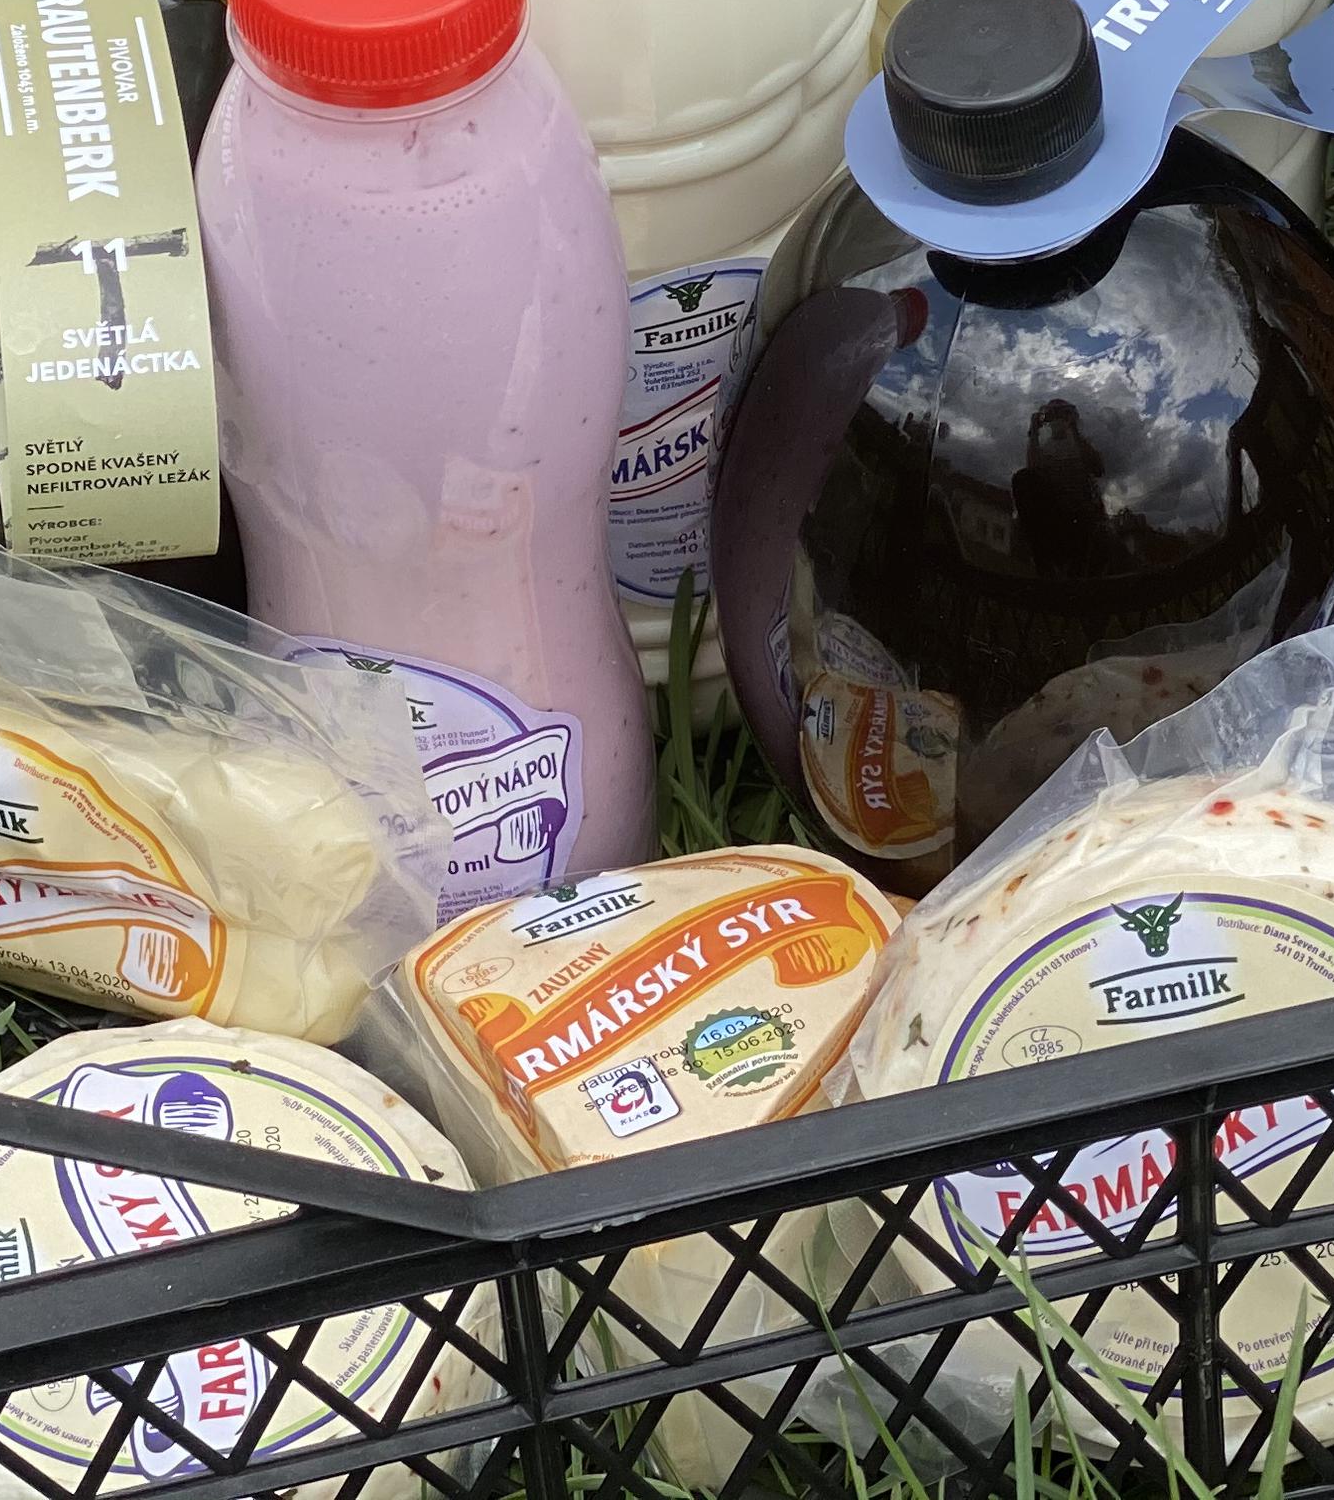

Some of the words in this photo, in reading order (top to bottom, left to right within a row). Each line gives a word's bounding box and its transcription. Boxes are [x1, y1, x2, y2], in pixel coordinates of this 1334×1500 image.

[10, 24, 29, 67] Založeno
[17, 68, 34, 94] 1045
[107, 38, 139, 103] PIVOVAR
[70, 237, 129, 275] 11
[62, 316, 160, 349] SVĚTLÁ
[644, 312, 738, 348] Farmilk
[25, 349, 201, 383] JEDENÁCTKA
[25, 436, 84, 456] SVĚTLÝ
[26, 456, 97, 476] SPODNĚ
[101, 450, 180, 470] KVAŠENÝ
[611, 413, 713, 485] MÁŘSK
[27, 470, 154, 495] NEFILTROVANÝ
[158, 468, 212, 485] LEŽÁK
[27, 518, 103, 531] VÝROBCE:
[29, 534, 89, 546] Pivovar
[494, 752, 558, 799] NÁPOJ
[466, 854, 491, 873] ml
[524, 893, 642, 940] Farmilk
[718, 898, 817, 949] SÝR
[1217, 916, 1263, 934] Distribuce:
[1263, 924, 1291, 943] Diana
[1291, 934, 1319, 954] Seven
[1035, 966, 1053, 984] 541
[1050, 958, 1063, 972] 03
[1059, 940, 1093, 966] Trutnov
[1273, 943, 1293, 958] 541
[1292, 950, 1305, 963] 03
[48, 960, 131, 991] 13.04.2020
[527, 941, 612, 1006] ZAUZENÝ
[1102, 969, 1233, 1014] Farmilk
[577, 1064, 630, 1094] datum
[700, 1002, 793, 1045] 16.03.2020
[1020, 1040, 1065, 1059] 19885
[1029, 1028, 1049, 1043] CZ
[583, 1067, 679, 1112] spotřebute
[712, 1018, 806, 1061] 15.06.2020
[1099, 1348, 1146, 1370] rizované
